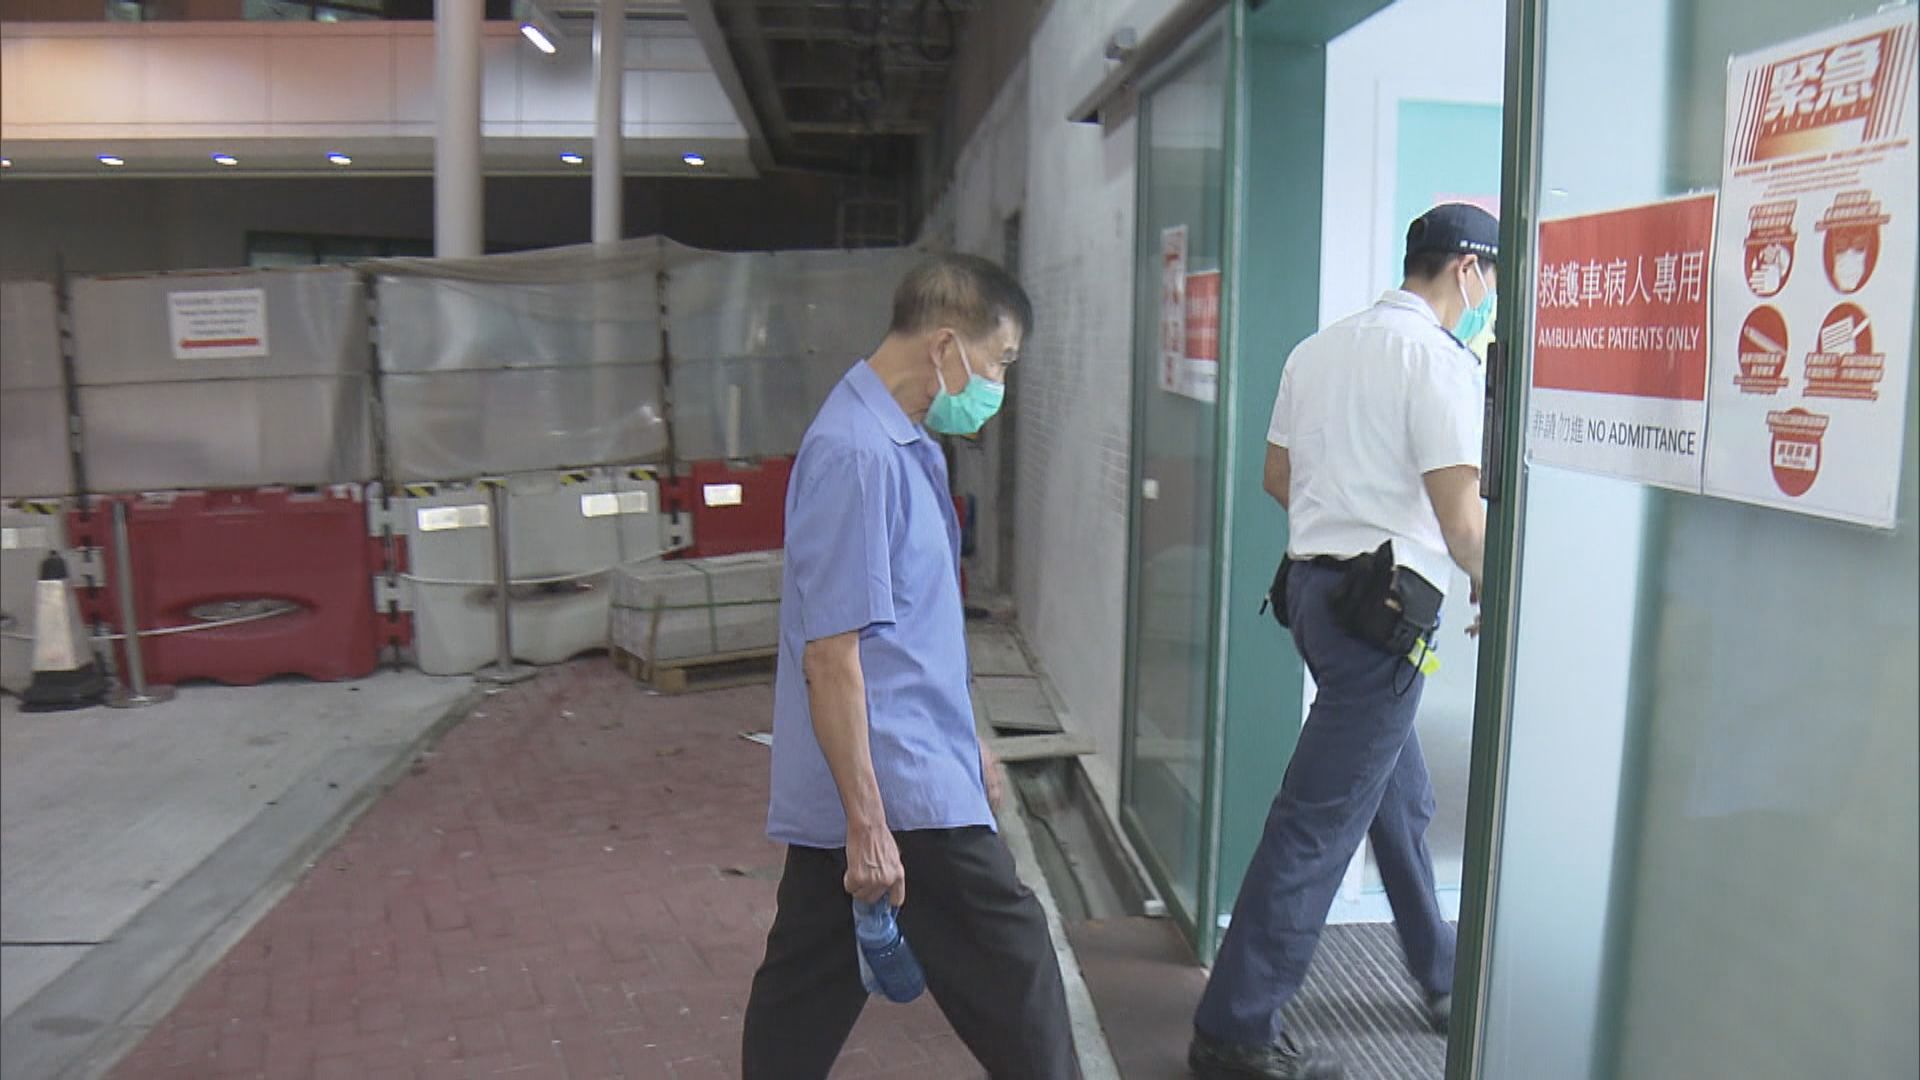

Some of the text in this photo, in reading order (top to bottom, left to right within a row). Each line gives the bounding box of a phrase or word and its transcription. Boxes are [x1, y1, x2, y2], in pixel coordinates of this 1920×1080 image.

[1764, 38, 1882, 121] 緊急
[1539, 252, 1703, 309] 救護車病人專用
[1538, 327, 1700, 351] AMBULANCE PATIENTS ONLY
[1587, 419, 1605, 443] NO
[1608, 422, 1696, 455] ADMITTANCE
